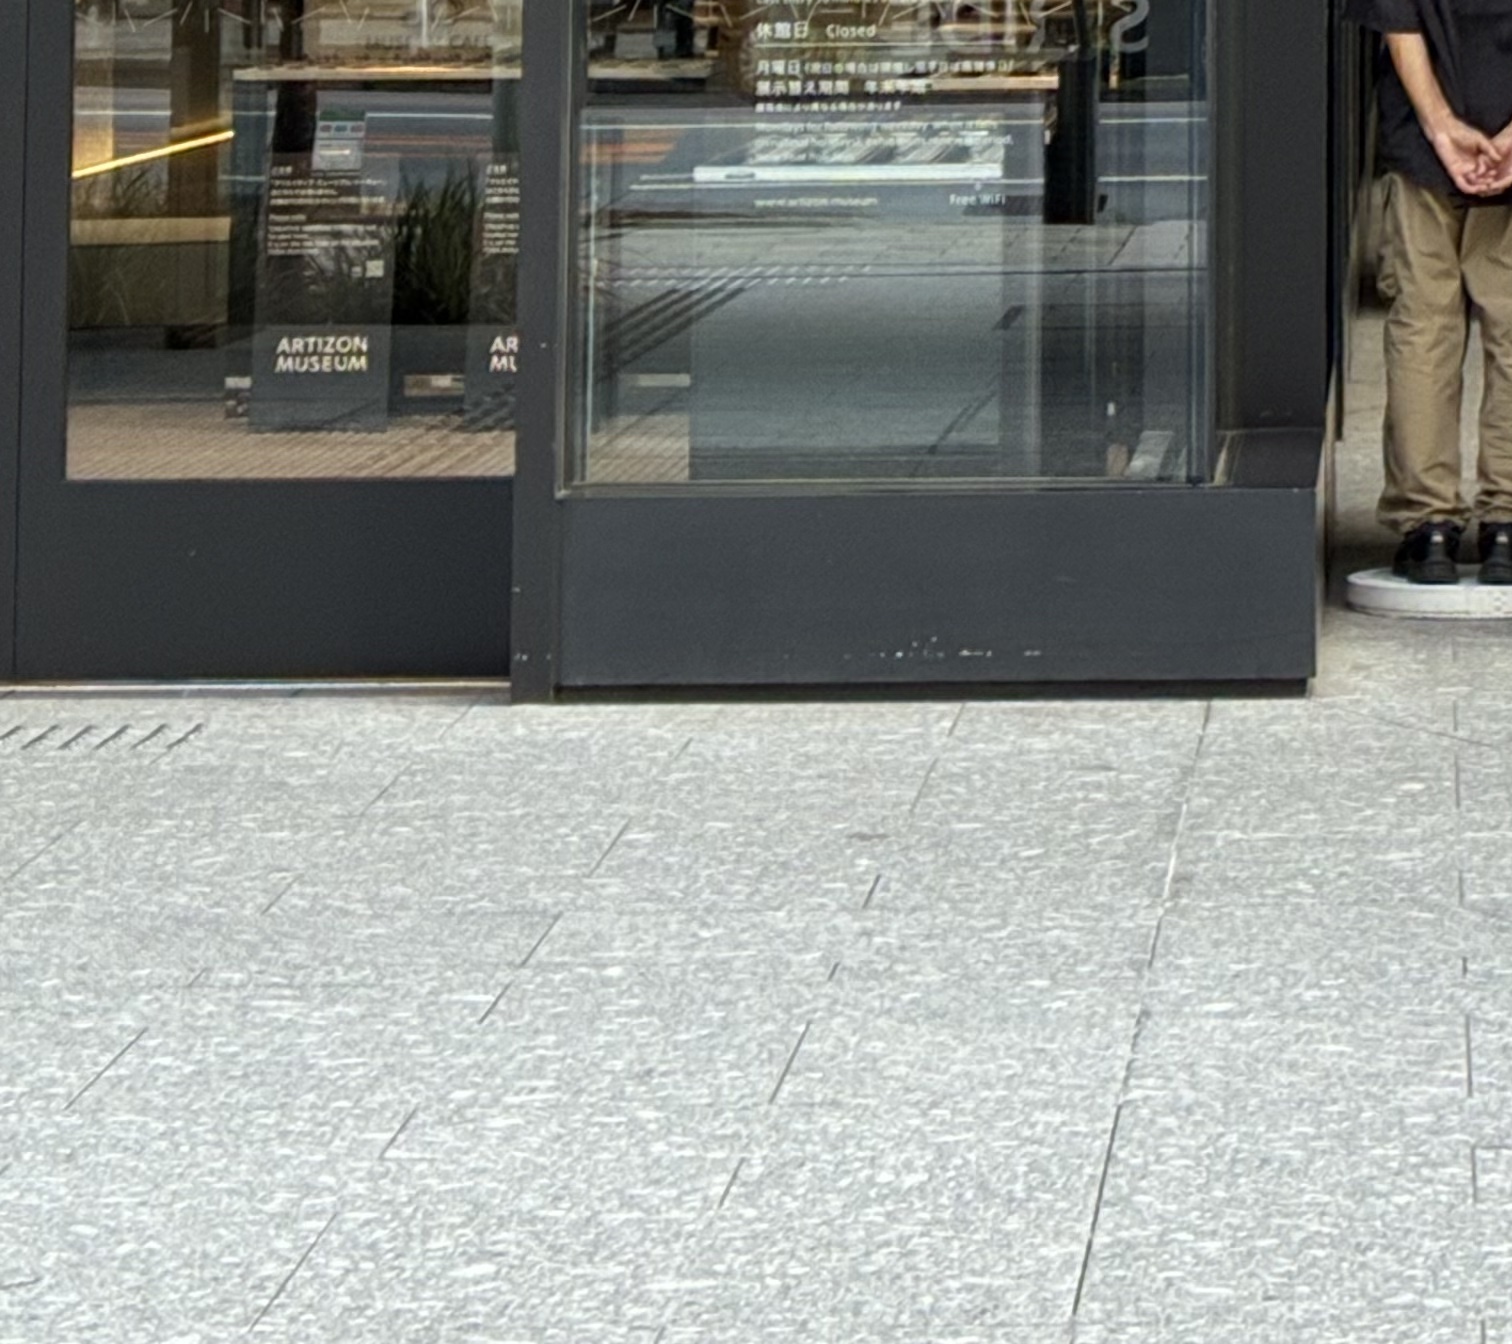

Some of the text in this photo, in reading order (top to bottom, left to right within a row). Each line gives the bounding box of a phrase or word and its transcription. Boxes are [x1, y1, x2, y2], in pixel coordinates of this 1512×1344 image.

[757, 22, 877, 40] 休館日 Closed
[950, 193, 977, 206] Free
[275, 335, 369, 355] ARTIZON
[274, 355, 368, 373] MUSEUM
